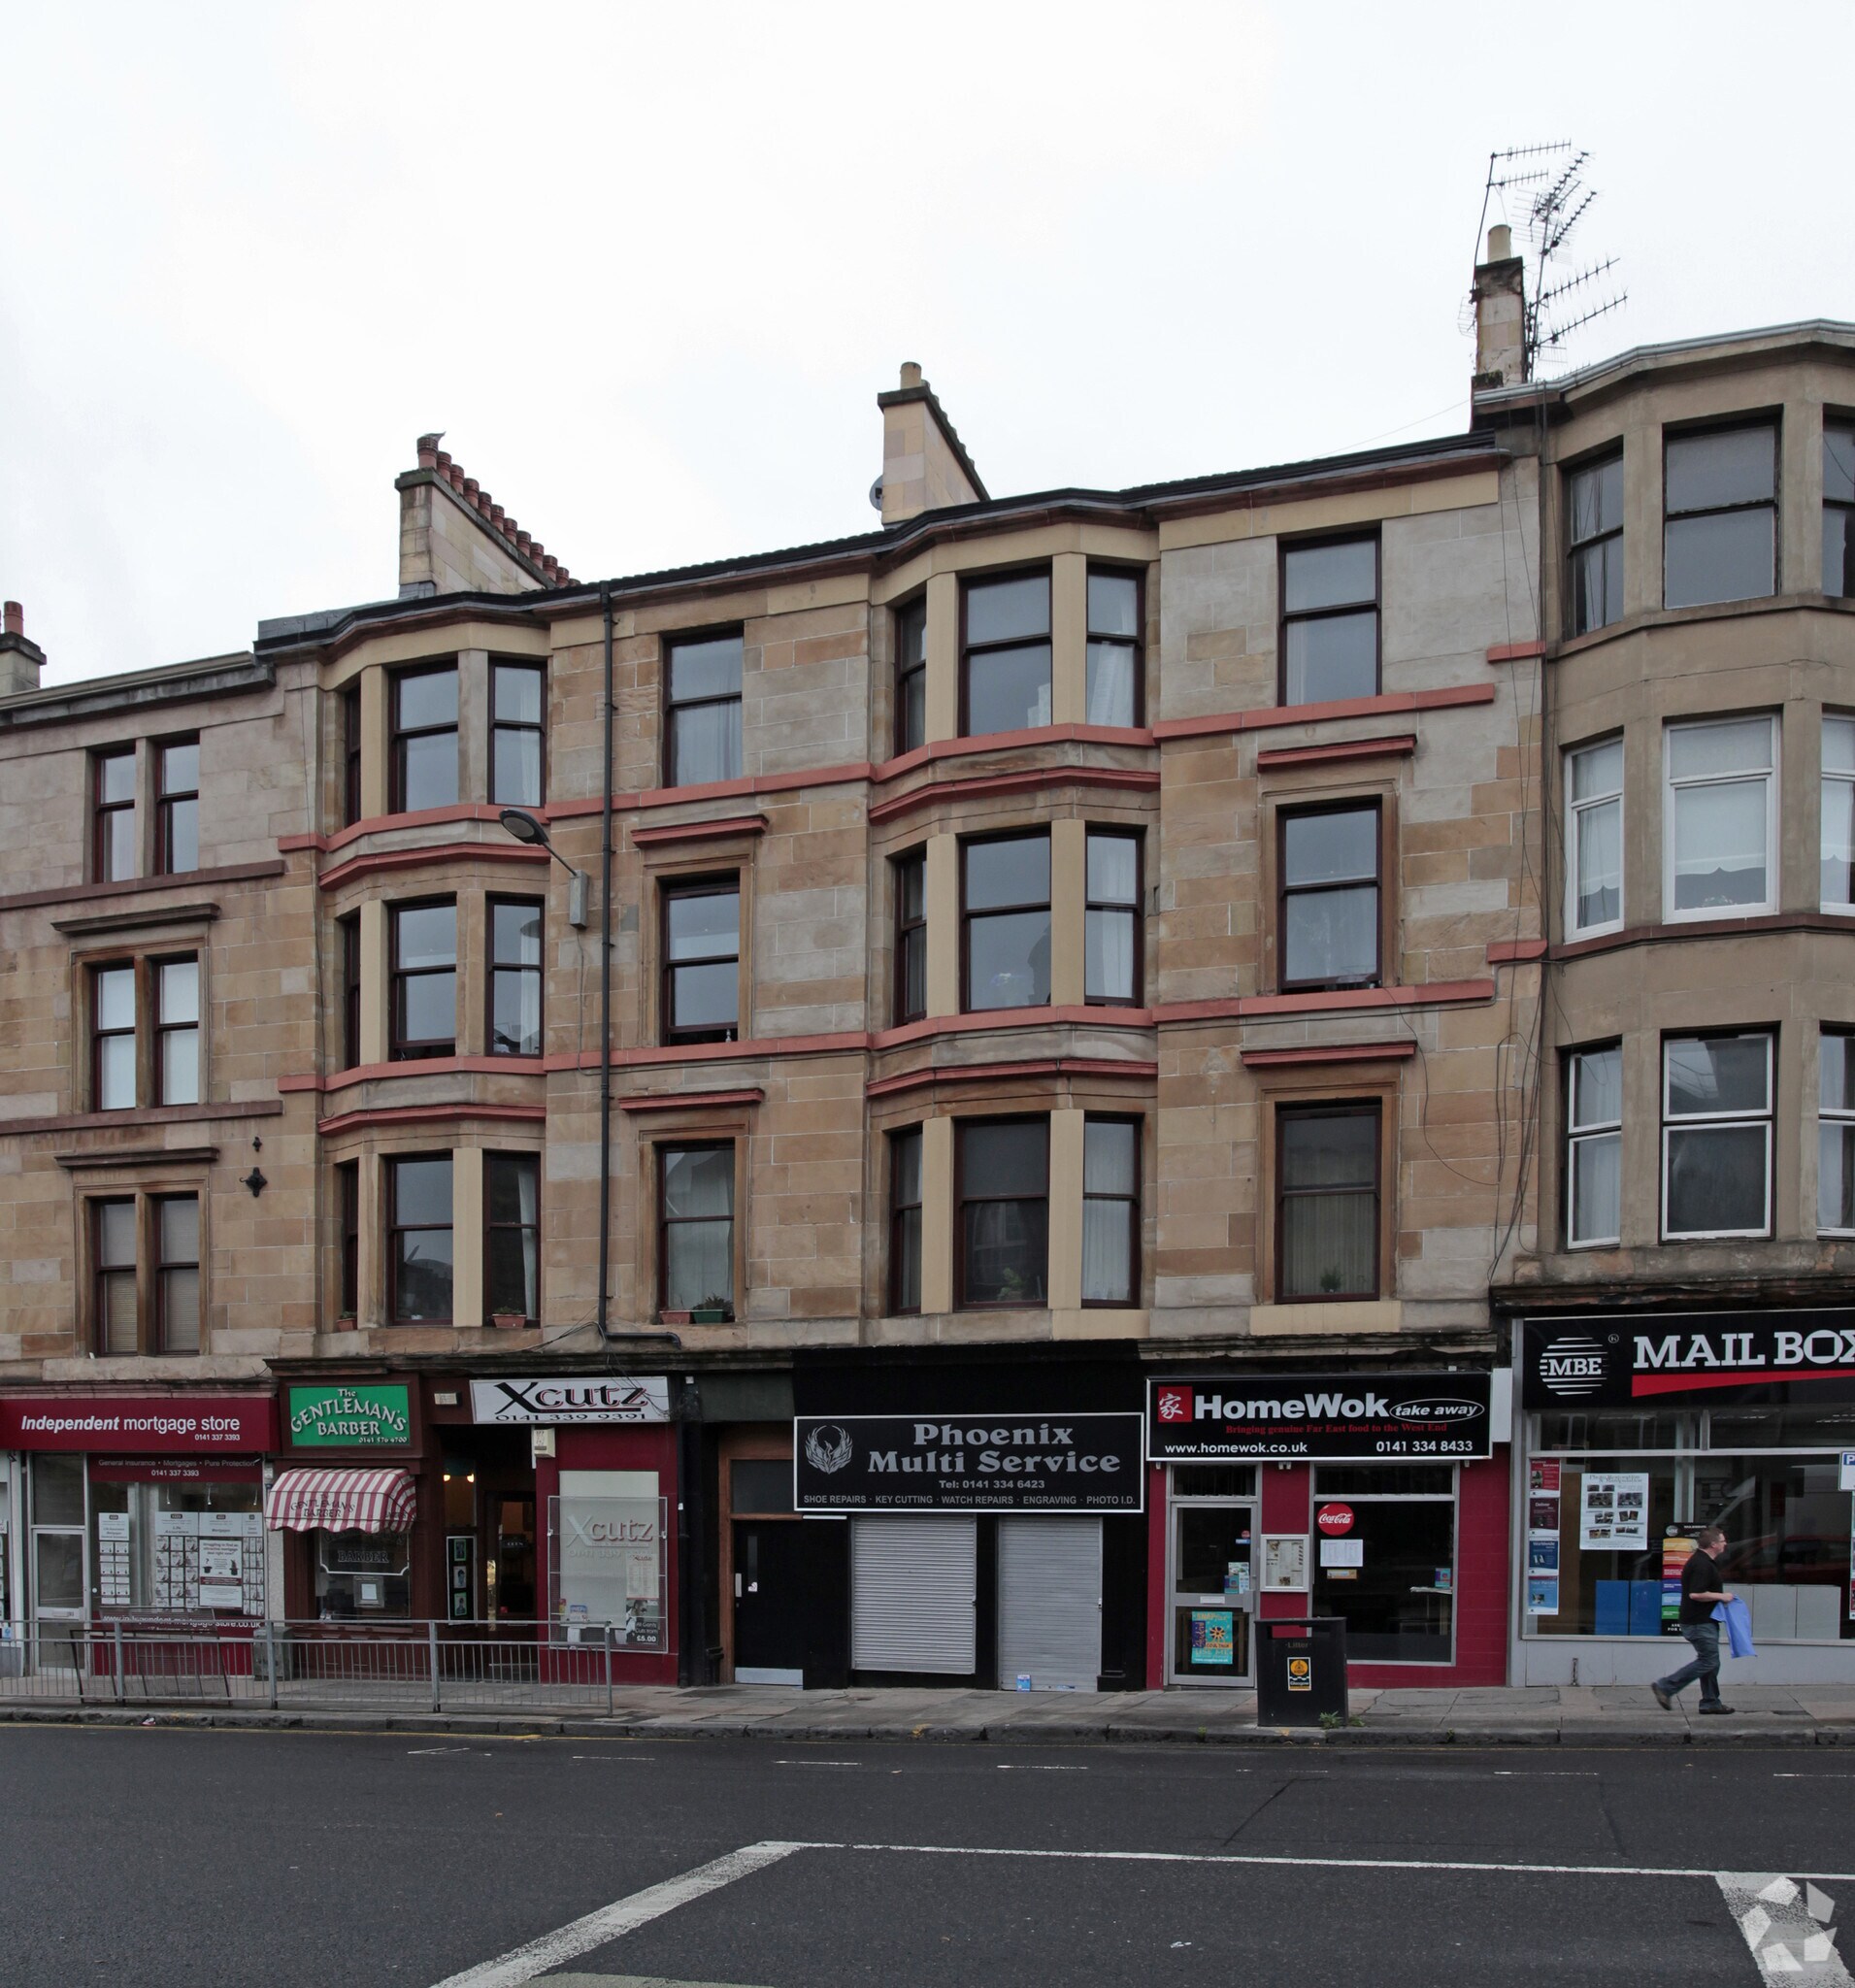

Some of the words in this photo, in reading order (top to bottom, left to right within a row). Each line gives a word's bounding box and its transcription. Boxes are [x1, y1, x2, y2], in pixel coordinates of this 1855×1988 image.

[1633, 1333, 1766, 1369] MAIL
[1548, 1357, 1602, 1376] MBE
[338, 1388, 356, 1397] The
[493, 1381, 648, 1414] Xcutz
[1158, 1392, 1184, 1419] 家
[1195, 1392, 1390, 1420] HomeWok
[1395, 1405, 1431, 1416] take
[1434, 1406, 1478, 1417] away
[21, 1415, 119, 1433] Independent
[123, 1416, 196, 1434] mortgage
[201, 1416, 241, 1431] store
[290, 1398, 407, 1433] GENTLEMAN'S
[316, 1421, 381, 1436] BARBER
[913, 1423, 1074, 1445] Phoenix
[1226, 1425, 1266, 1435] Bringing
[1268, 1425, 1304, 1435] genuine
[1306, 1424, 1323, 1433] Far
[1326, 1424, 1346, 1433] East
[1348, 1424, 1370, 1433] food
[1372, 1424, 1381, 1433] to
[1383, 1423, 1399, 1433] the
[1401, 1423, 1425, 1432] West
[1428, 1423, 1447, 1432] End
[1165, 1441, 1308, 1453] www.homewok.co.uk
[1375, 1441, 1408, 1452] 0141
[1412, 1441, 1437, 1452] 334
[1441, 1441, 1474, 1452] 8433
[868, 1450, 965, 1473] Multi
[977, 1450, 1120, 1473] Service
[804, 1495, 827, 1504] SHOE
[829, 1495, 867, 1504] REPAIRS
[875, 1495, 893, 1504] KEY
[894, 1495, 933, 1504] CUTTING
[975, 1496, 1013, 1505] REPAIRS
[1023, 1496, 1077, 1505] ENGRAVING
[1086, 1496, 1119, 1505] PHOTO
[1120, 1496, 1136, 1505] I.D.
[303, 1508, 342, 1517] BARBER
[566, 1515, 653, 1548] Xcutz
[338, 1550, 389, 1564] BARBER
